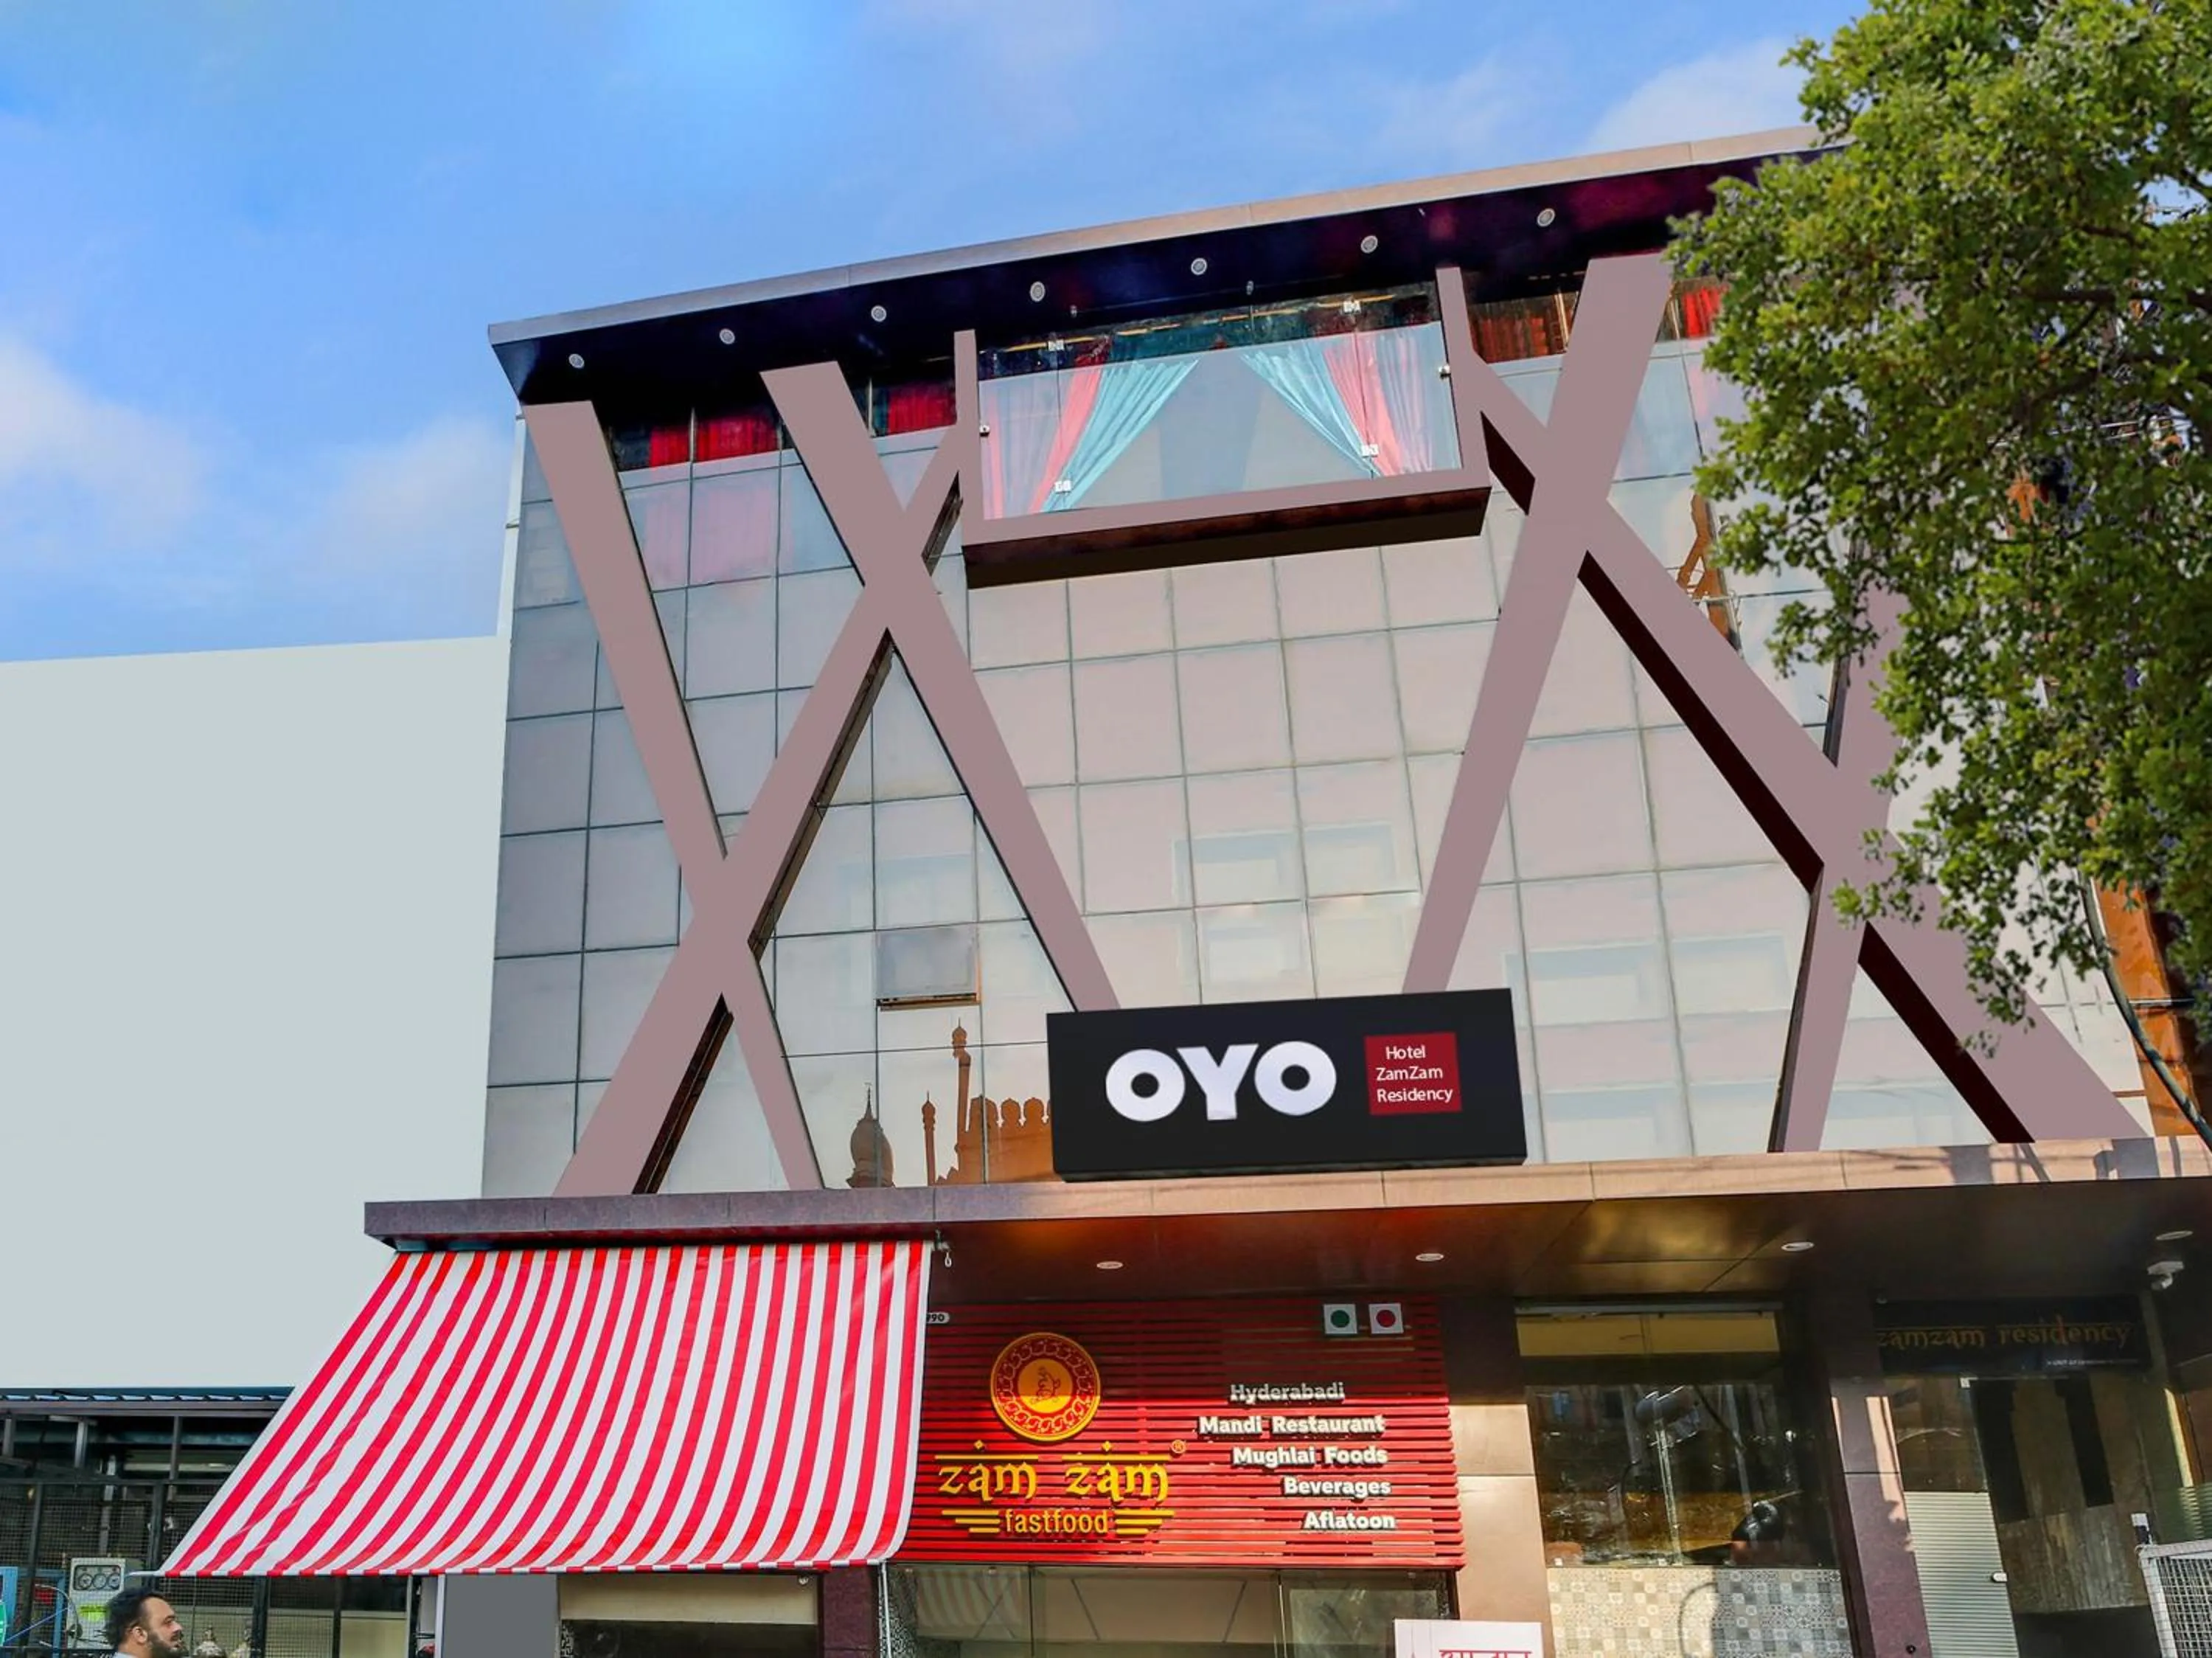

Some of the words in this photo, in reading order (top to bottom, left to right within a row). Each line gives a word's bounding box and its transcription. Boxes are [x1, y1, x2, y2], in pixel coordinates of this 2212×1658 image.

[1385, 1044, 1426, 1060] Hotel
[1105, 1041, 1337, 1122] OYO
[1375, 1066, 1443, 1081] ZamZam
[1376, 1088, 1453, 1103] Residency
[2000, 1314, 2131, 1348] residency
[1229, 1381, 1345, 1404] Hyderabadi
[1198, 1415, 1263, 1434] Mandi
[1271, 1414, 1385, 1434] Restaurant
[1232, 1446, 1316, 1468] Mughlai
[1324, 1446, 1388, 1464] Foods
[1283, 1475, 1391, 1498] Beverages
[1005, 1508, 1108, 1533] fastfood
[1303, 1510, 1396, 1530] Aflatoon
